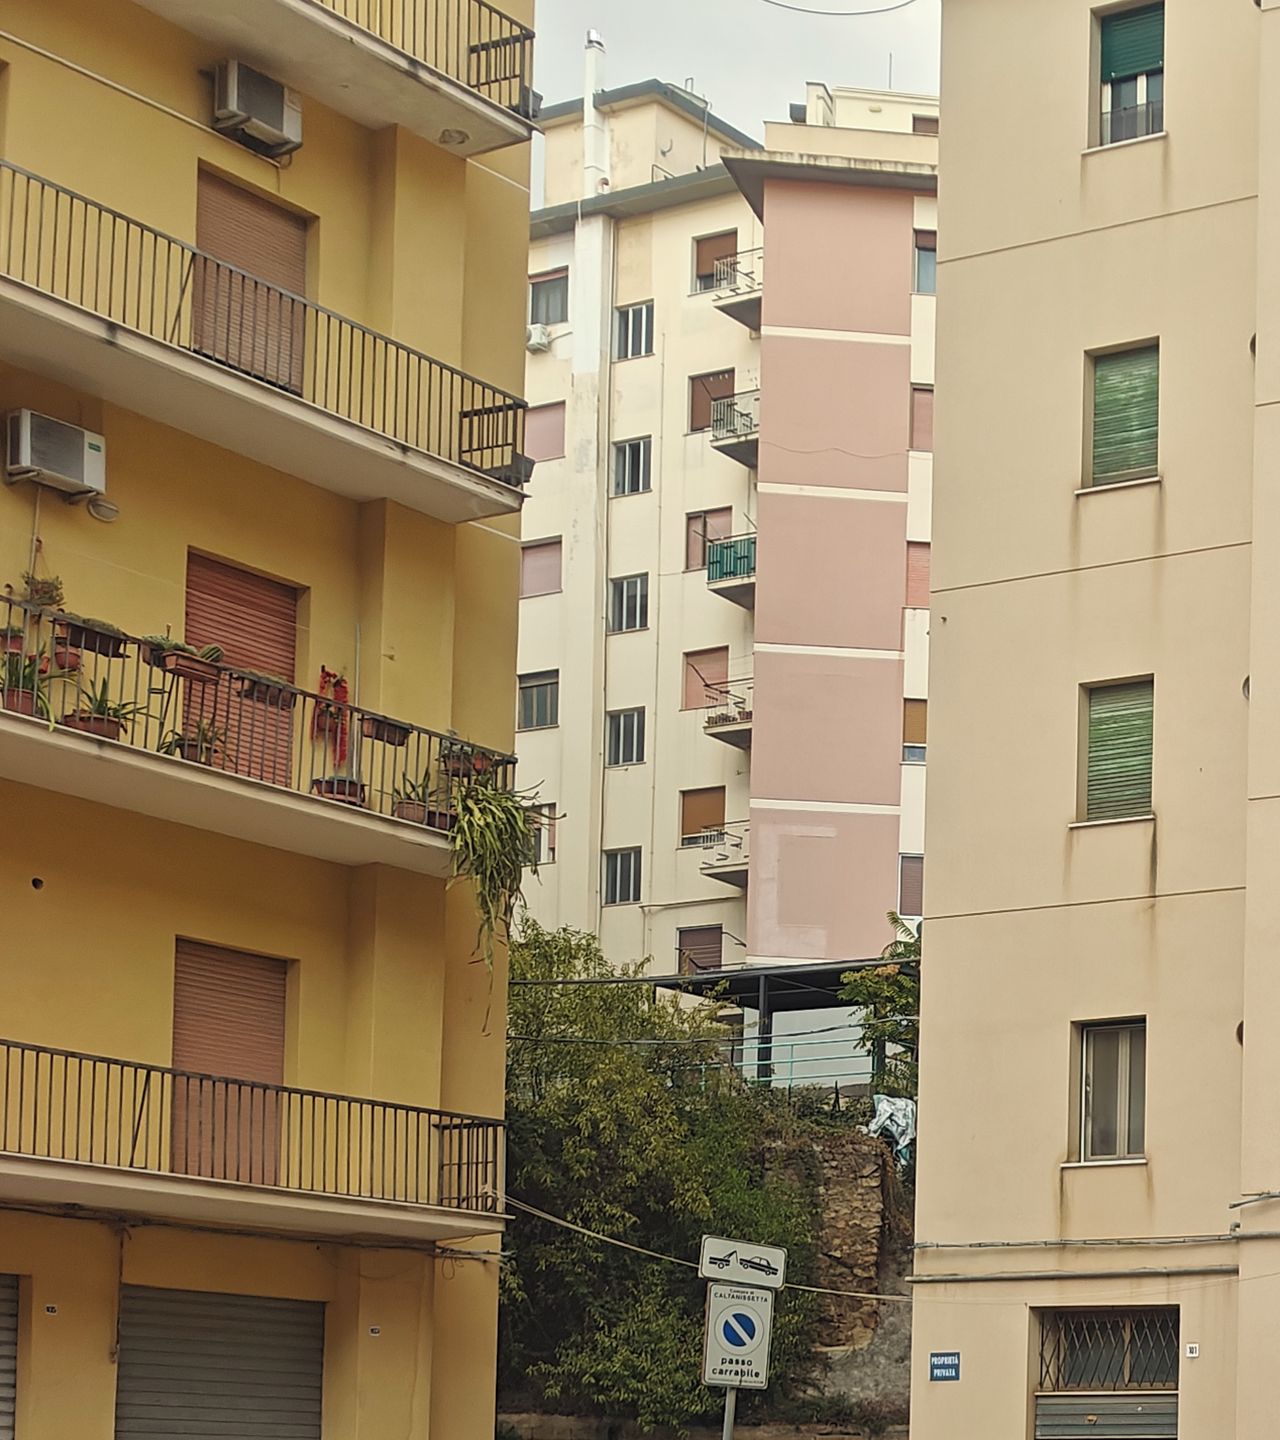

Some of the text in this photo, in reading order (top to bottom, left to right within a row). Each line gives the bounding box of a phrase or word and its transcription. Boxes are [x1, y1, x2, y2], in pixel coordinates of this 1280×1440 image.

[713, 1292, 768, 1303] CALTANISSETTA
[721, 1357, 753, 1366] passo
[712, 1367, 760, 1378] carrabile
